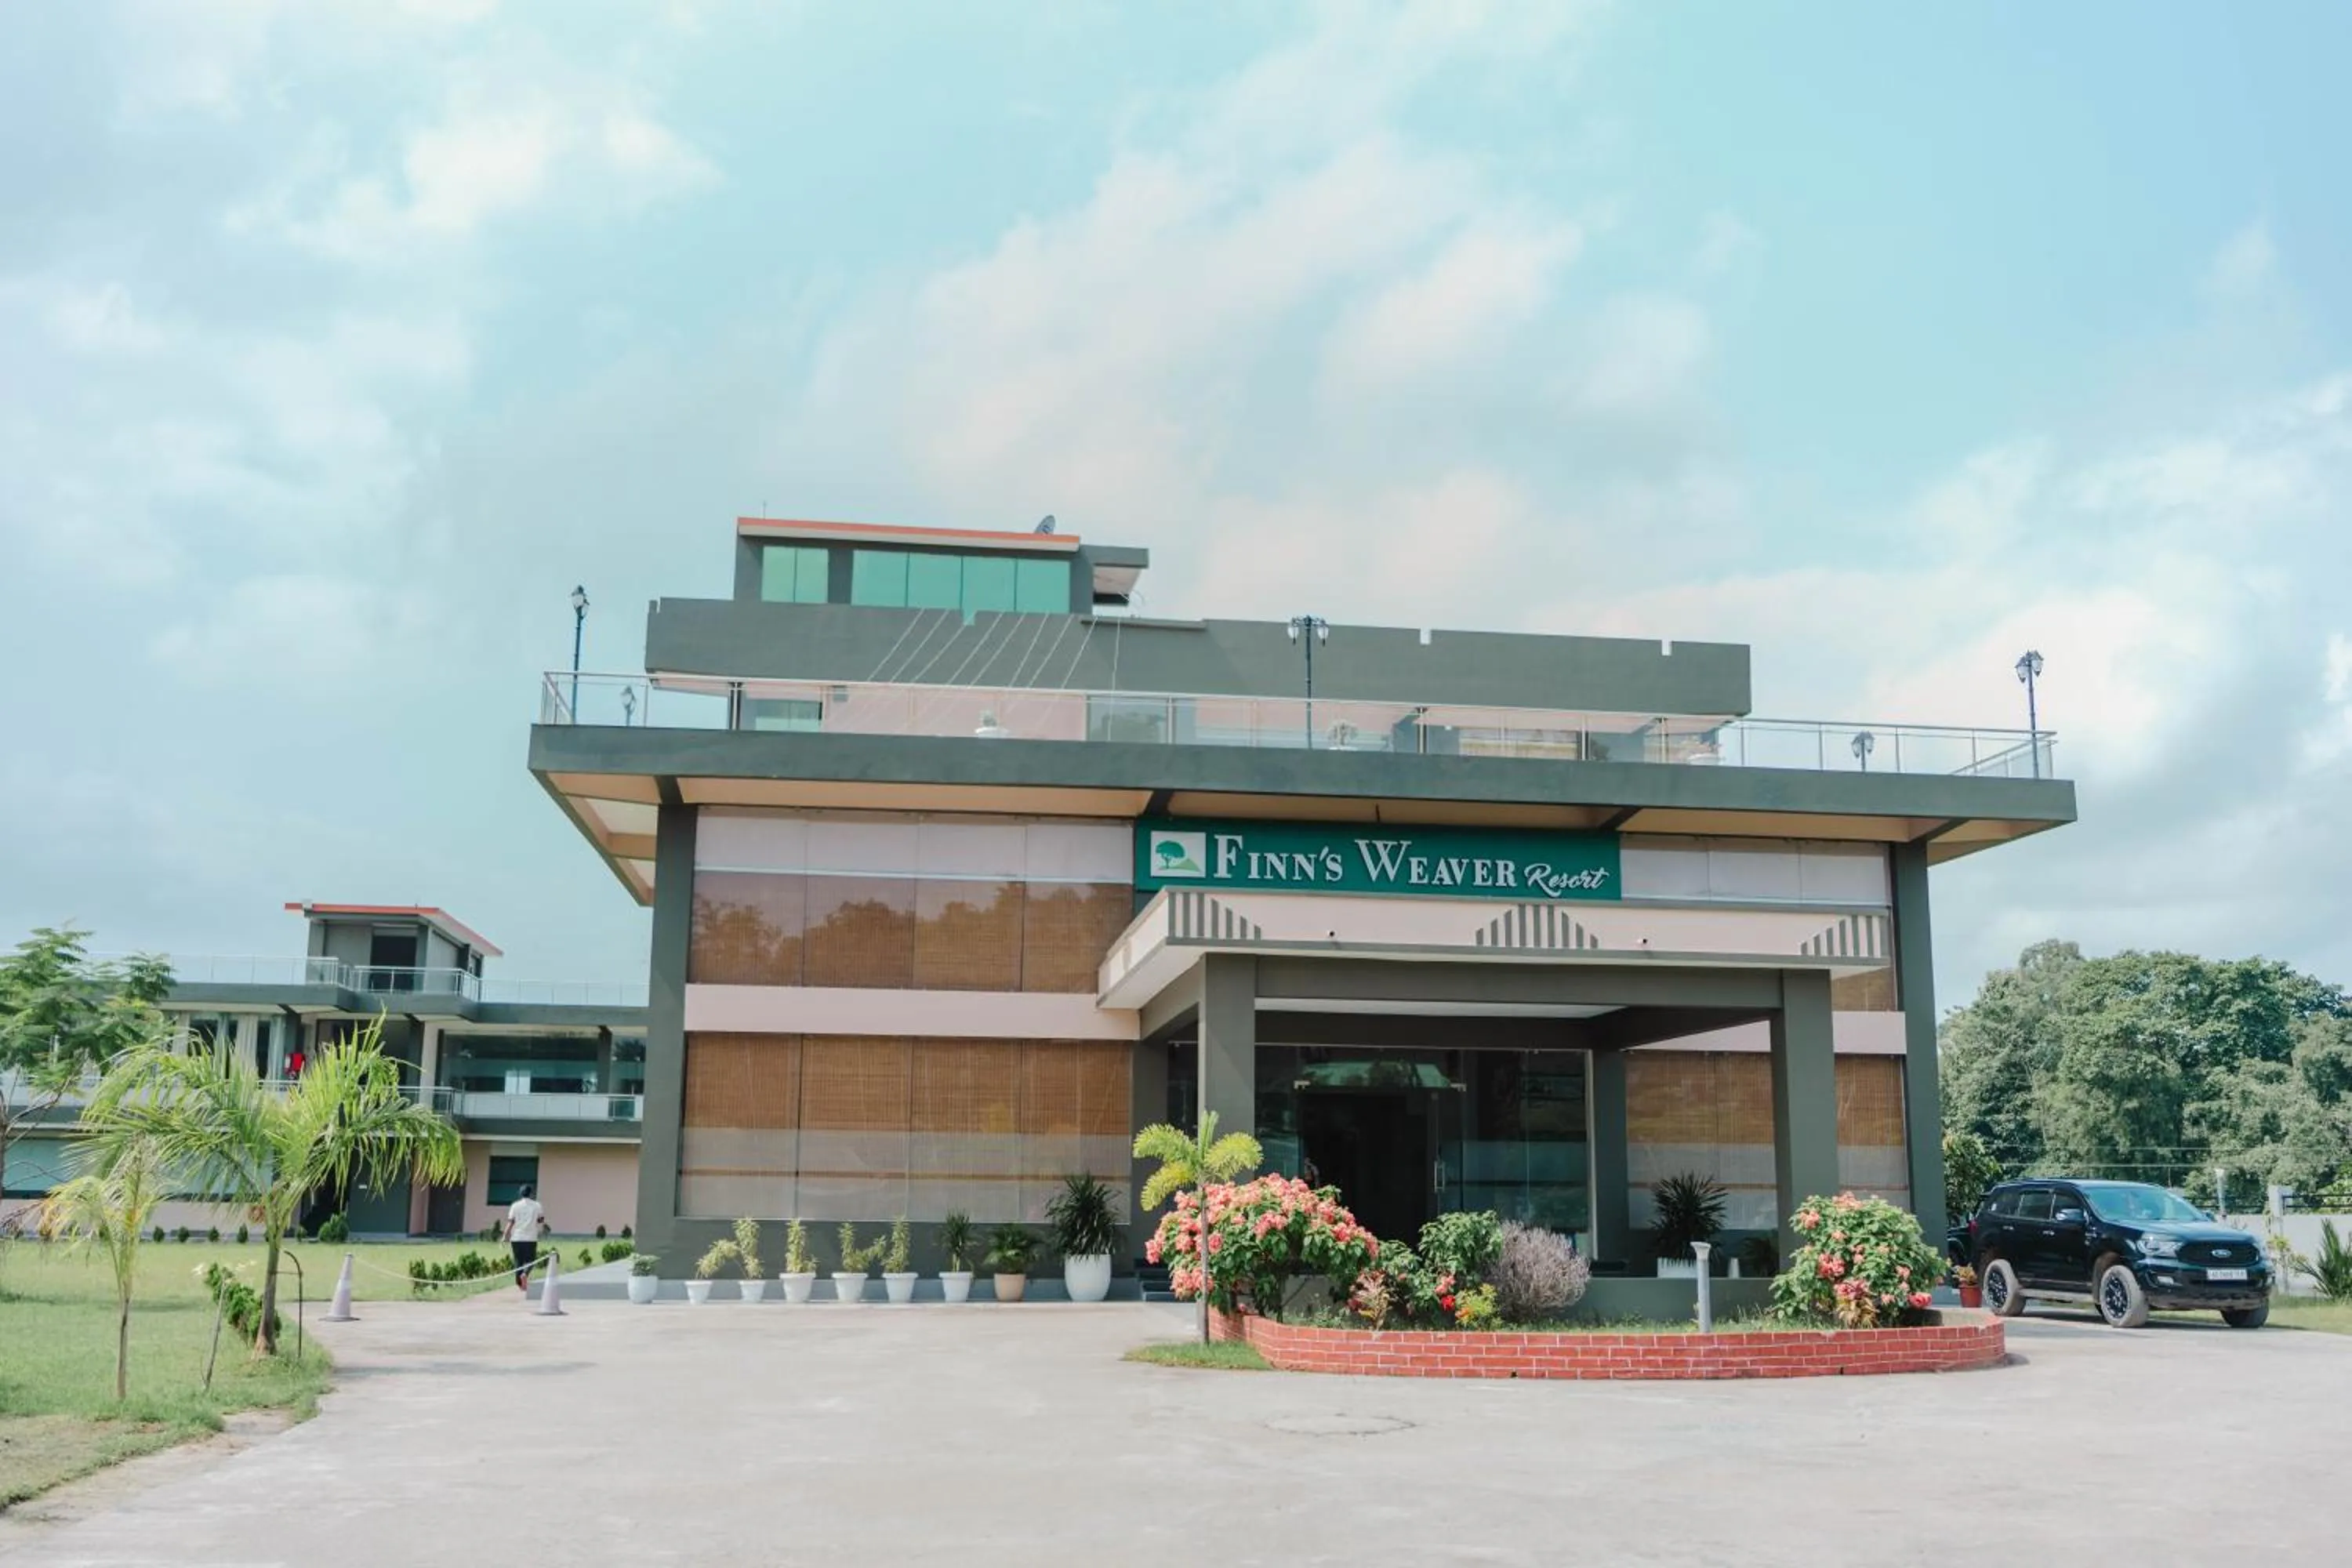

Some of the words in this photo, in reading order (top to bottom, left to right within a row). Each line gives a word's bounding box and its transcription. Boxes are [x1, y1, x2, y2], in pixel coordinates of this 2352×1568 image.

[1214, 834, 1343, 881] FINN'S
[1355, 839, 1517, 887] WEAVER
[1524, 863, 1610, 897] Resort
